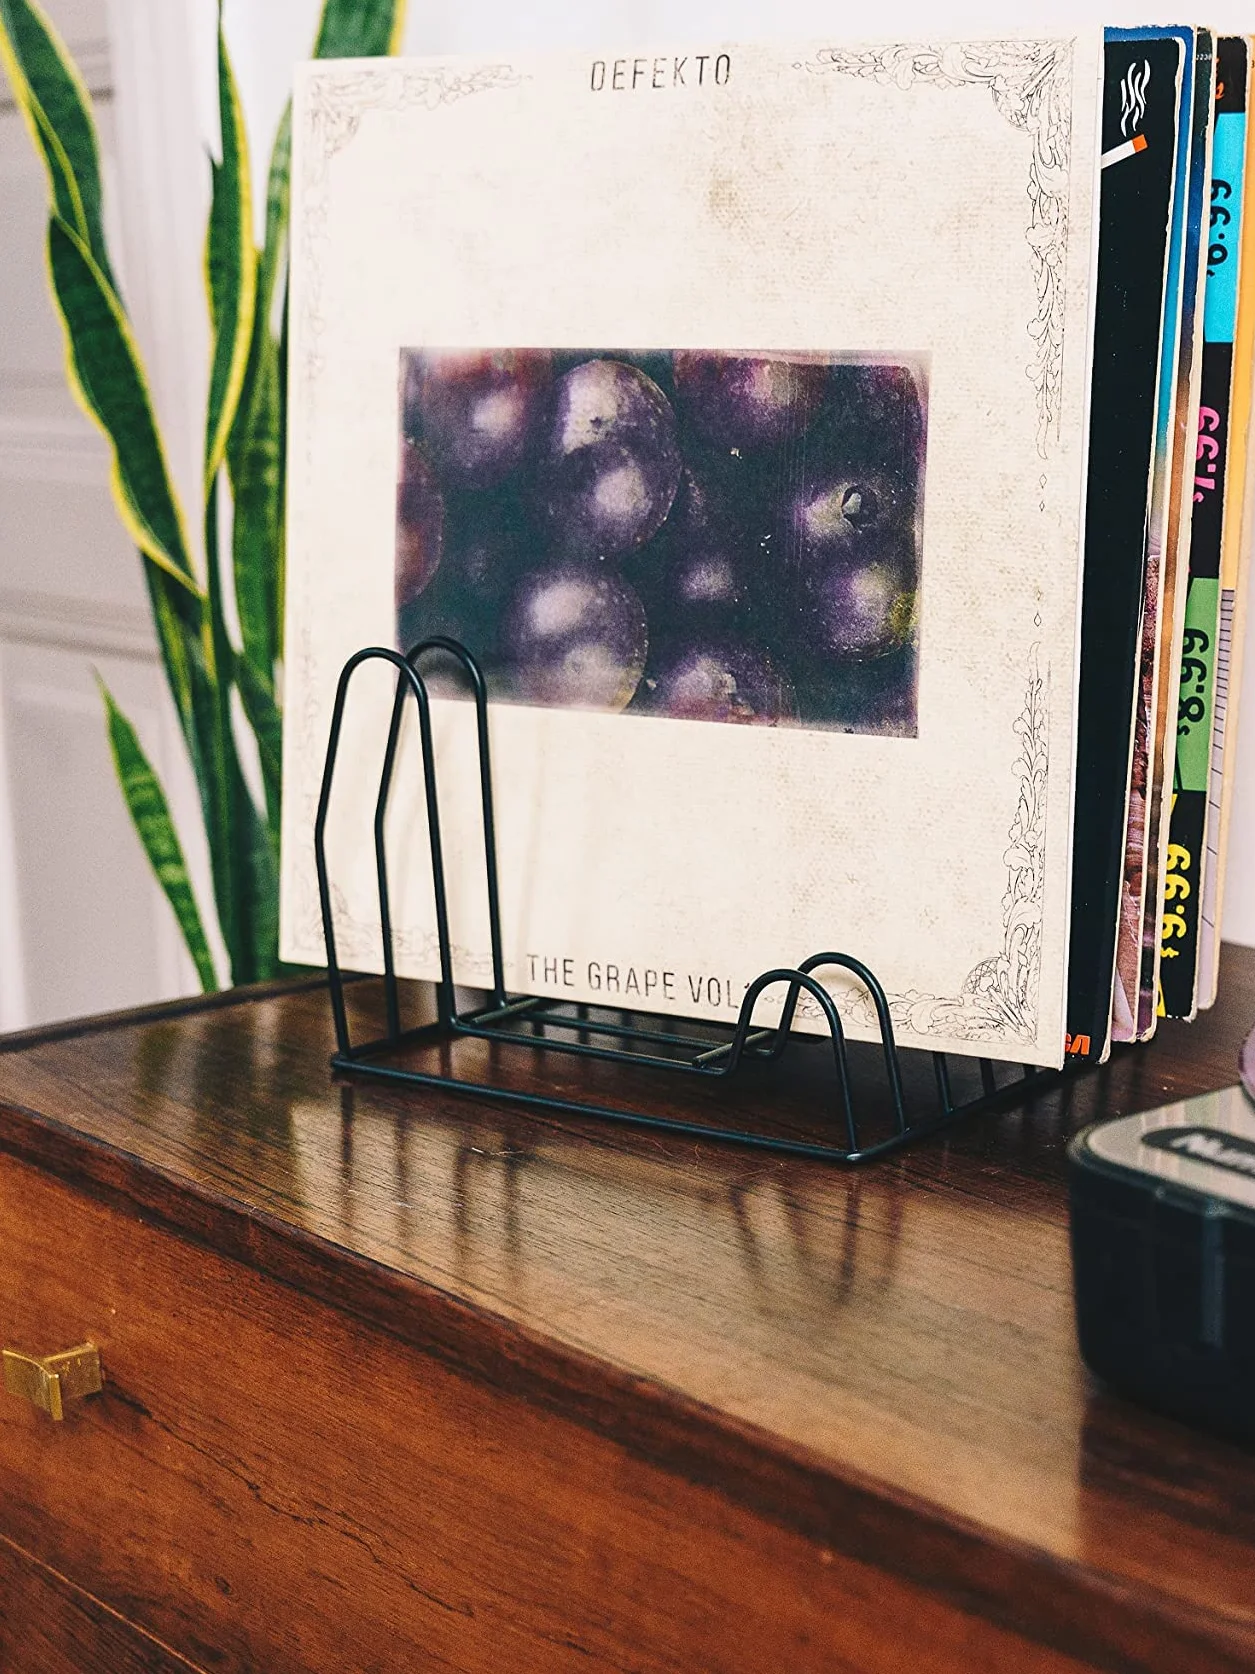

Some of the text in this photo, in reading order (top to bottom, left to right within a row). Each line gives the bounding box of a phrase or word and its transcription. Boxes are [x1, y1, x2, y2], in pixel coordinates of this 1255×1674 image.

[590, 53, 731, 92] DEFEKTO
[526, 953, 576, 988] THE
[587, 960, 677, 1001] GRAPE
